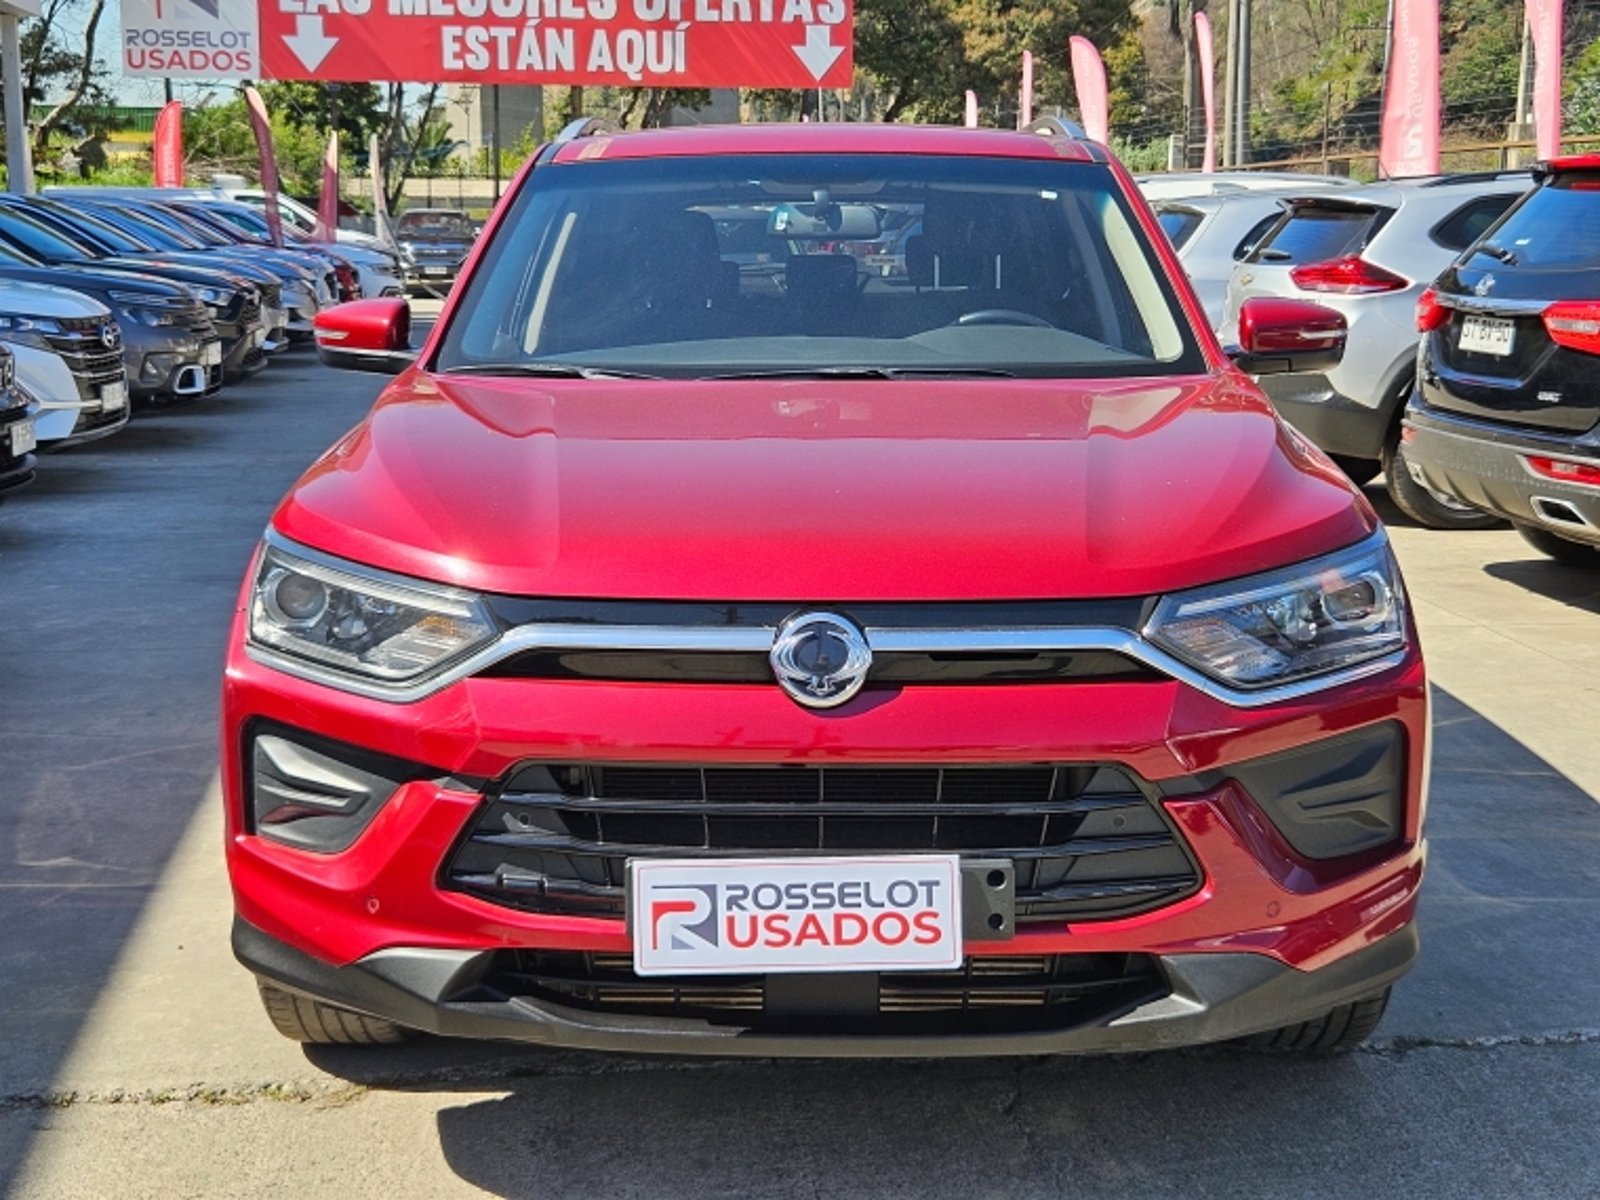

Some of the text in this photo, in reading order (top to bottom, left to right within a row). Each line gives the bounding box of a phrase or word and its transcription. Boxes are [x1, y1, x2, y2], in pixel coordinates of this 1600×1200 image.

[126, 28, 251, 49] ROSSELOT
[441, 18, 691, 81] ESTÁN AQUÍ
[127, 49, 252, 71] USADOS
[726, 879, 941, 911] ROSSELOT
[726, 911, 942, 949] USADOS
